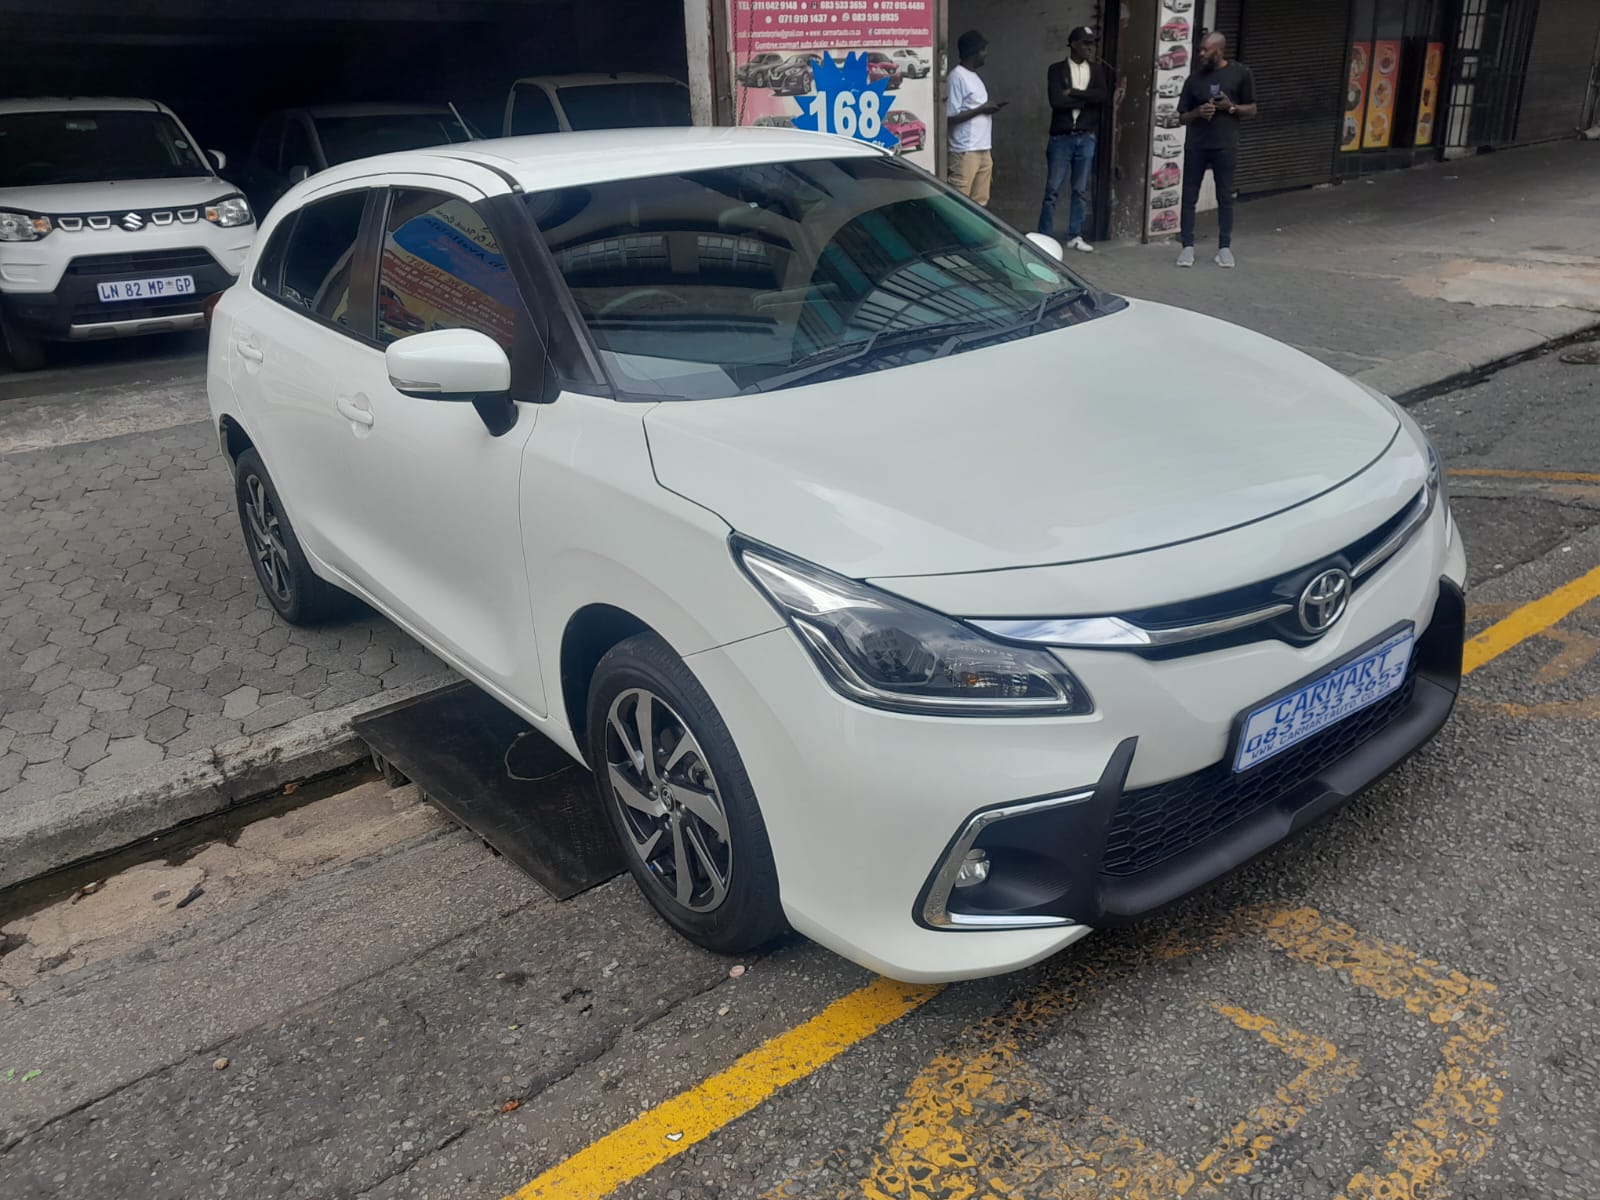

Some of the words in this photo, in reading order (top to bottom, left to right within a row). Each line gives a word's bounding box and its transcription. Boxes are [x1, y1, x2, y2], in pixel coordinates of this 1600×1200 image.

[809, 90, 881, 138] 168
[100, 284, 119, 300] LN
[125, 282, 142, 297] 82
[148, 280, 164, 295] MP
[175, 278, 191, 293] GP
[1245, 717, 1296, 753] 083
[1300, 691, 1344, 726] 533
[1350, 660, 1404, 699] 3653
[1275, 648, 1392, 725] CARMART
